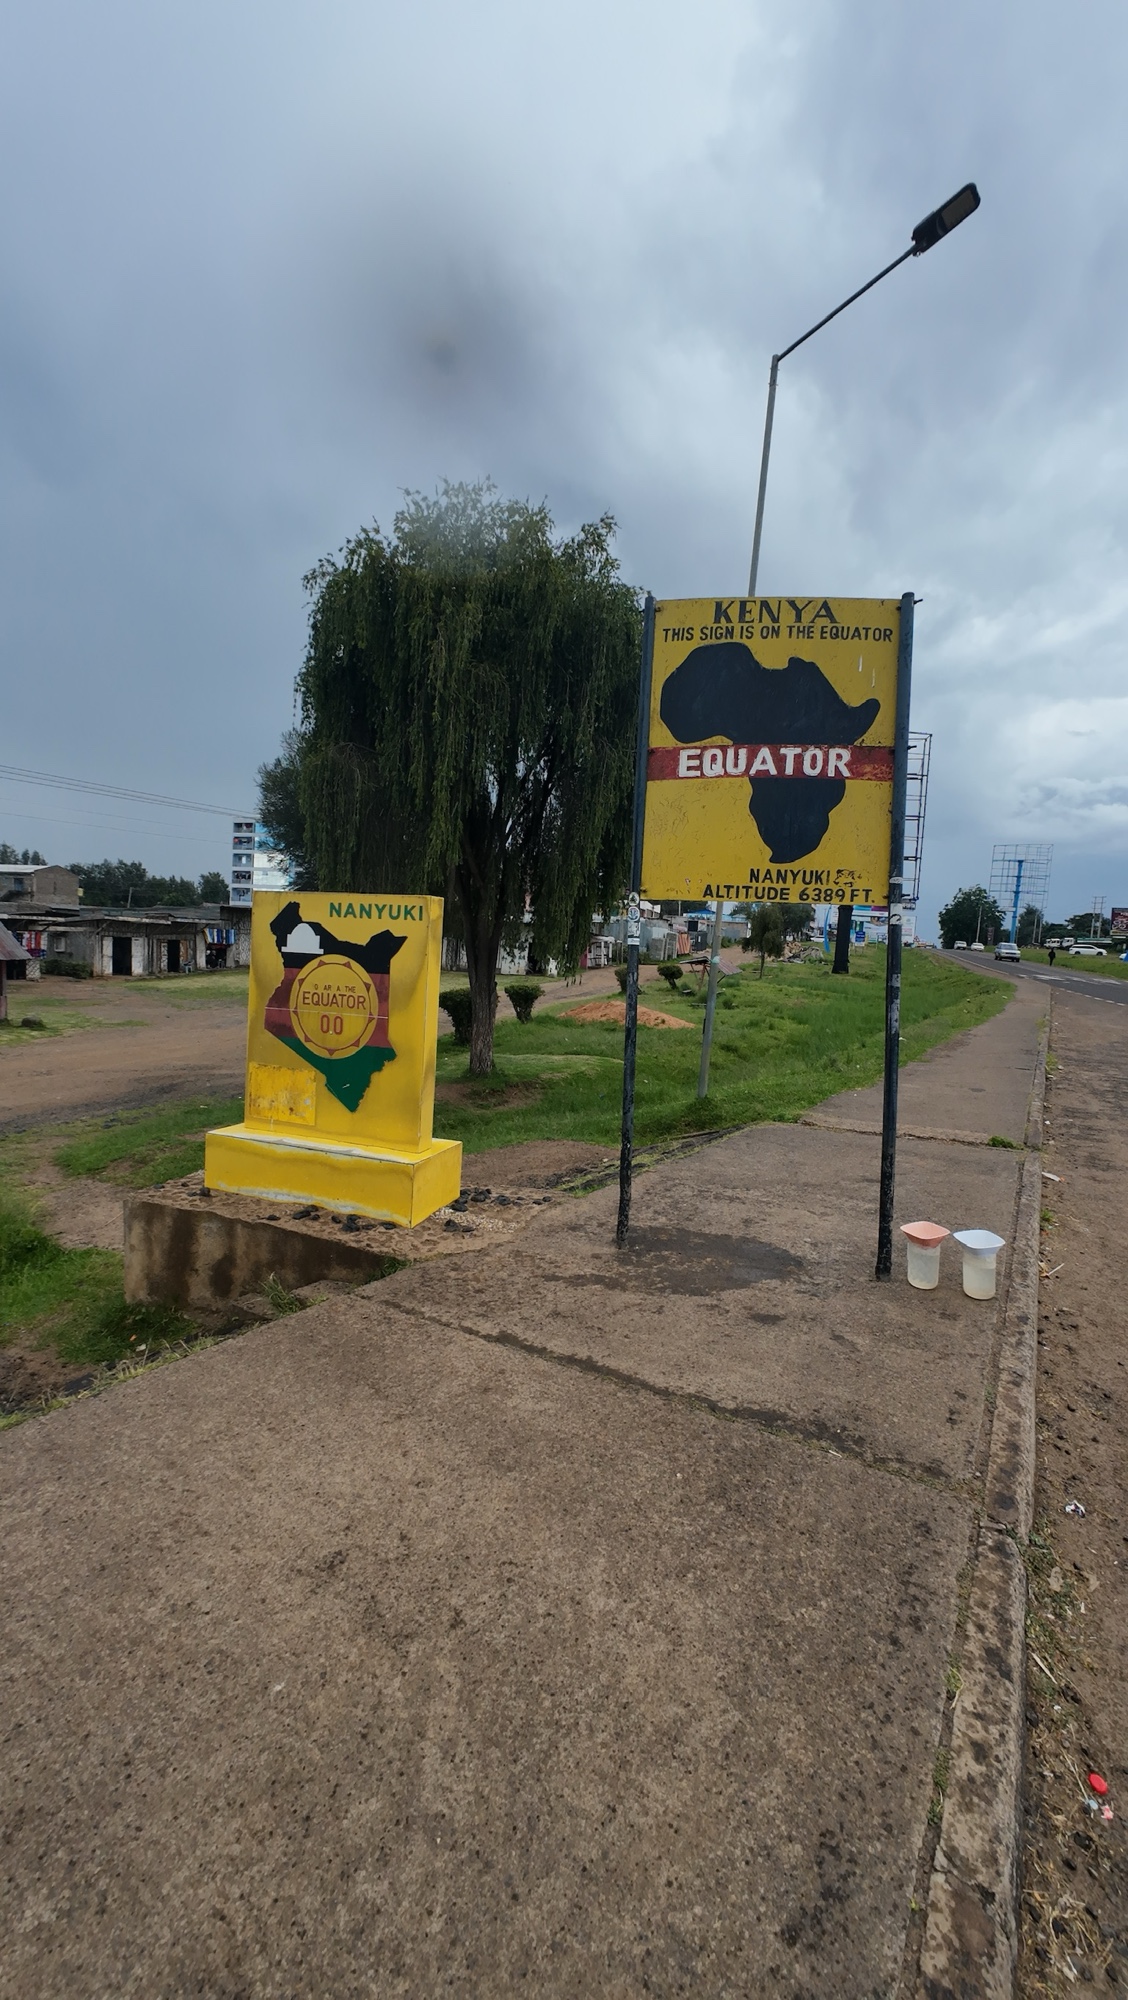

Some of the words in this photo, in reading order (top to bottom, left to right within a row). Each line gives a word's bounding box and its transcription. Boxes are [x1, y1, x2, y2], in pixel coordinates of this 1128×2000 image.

[713, 600, 840, 624] KENYA
[662, 627, 694, 643] THIS
[700, 625, 734, 641] SIGN
[740, 625, 754, 640] IS
[760, 625, 780, 640] ON
[786, 625, 814, 640] THE
[820, 626, 893, 643] EQUATOR
[678, 746, 851, 778] EQUATOR
[750, 868, 830, 885] NANYUKI
[702, 884, 790, 900] ALTITUDE
[798, 887, 845, 902] 6389
[850, 888, 875, 903] FT.
[329, 902, 423, 921] NANYUKI
[302, 991, 366, 1010] EQUATOR
